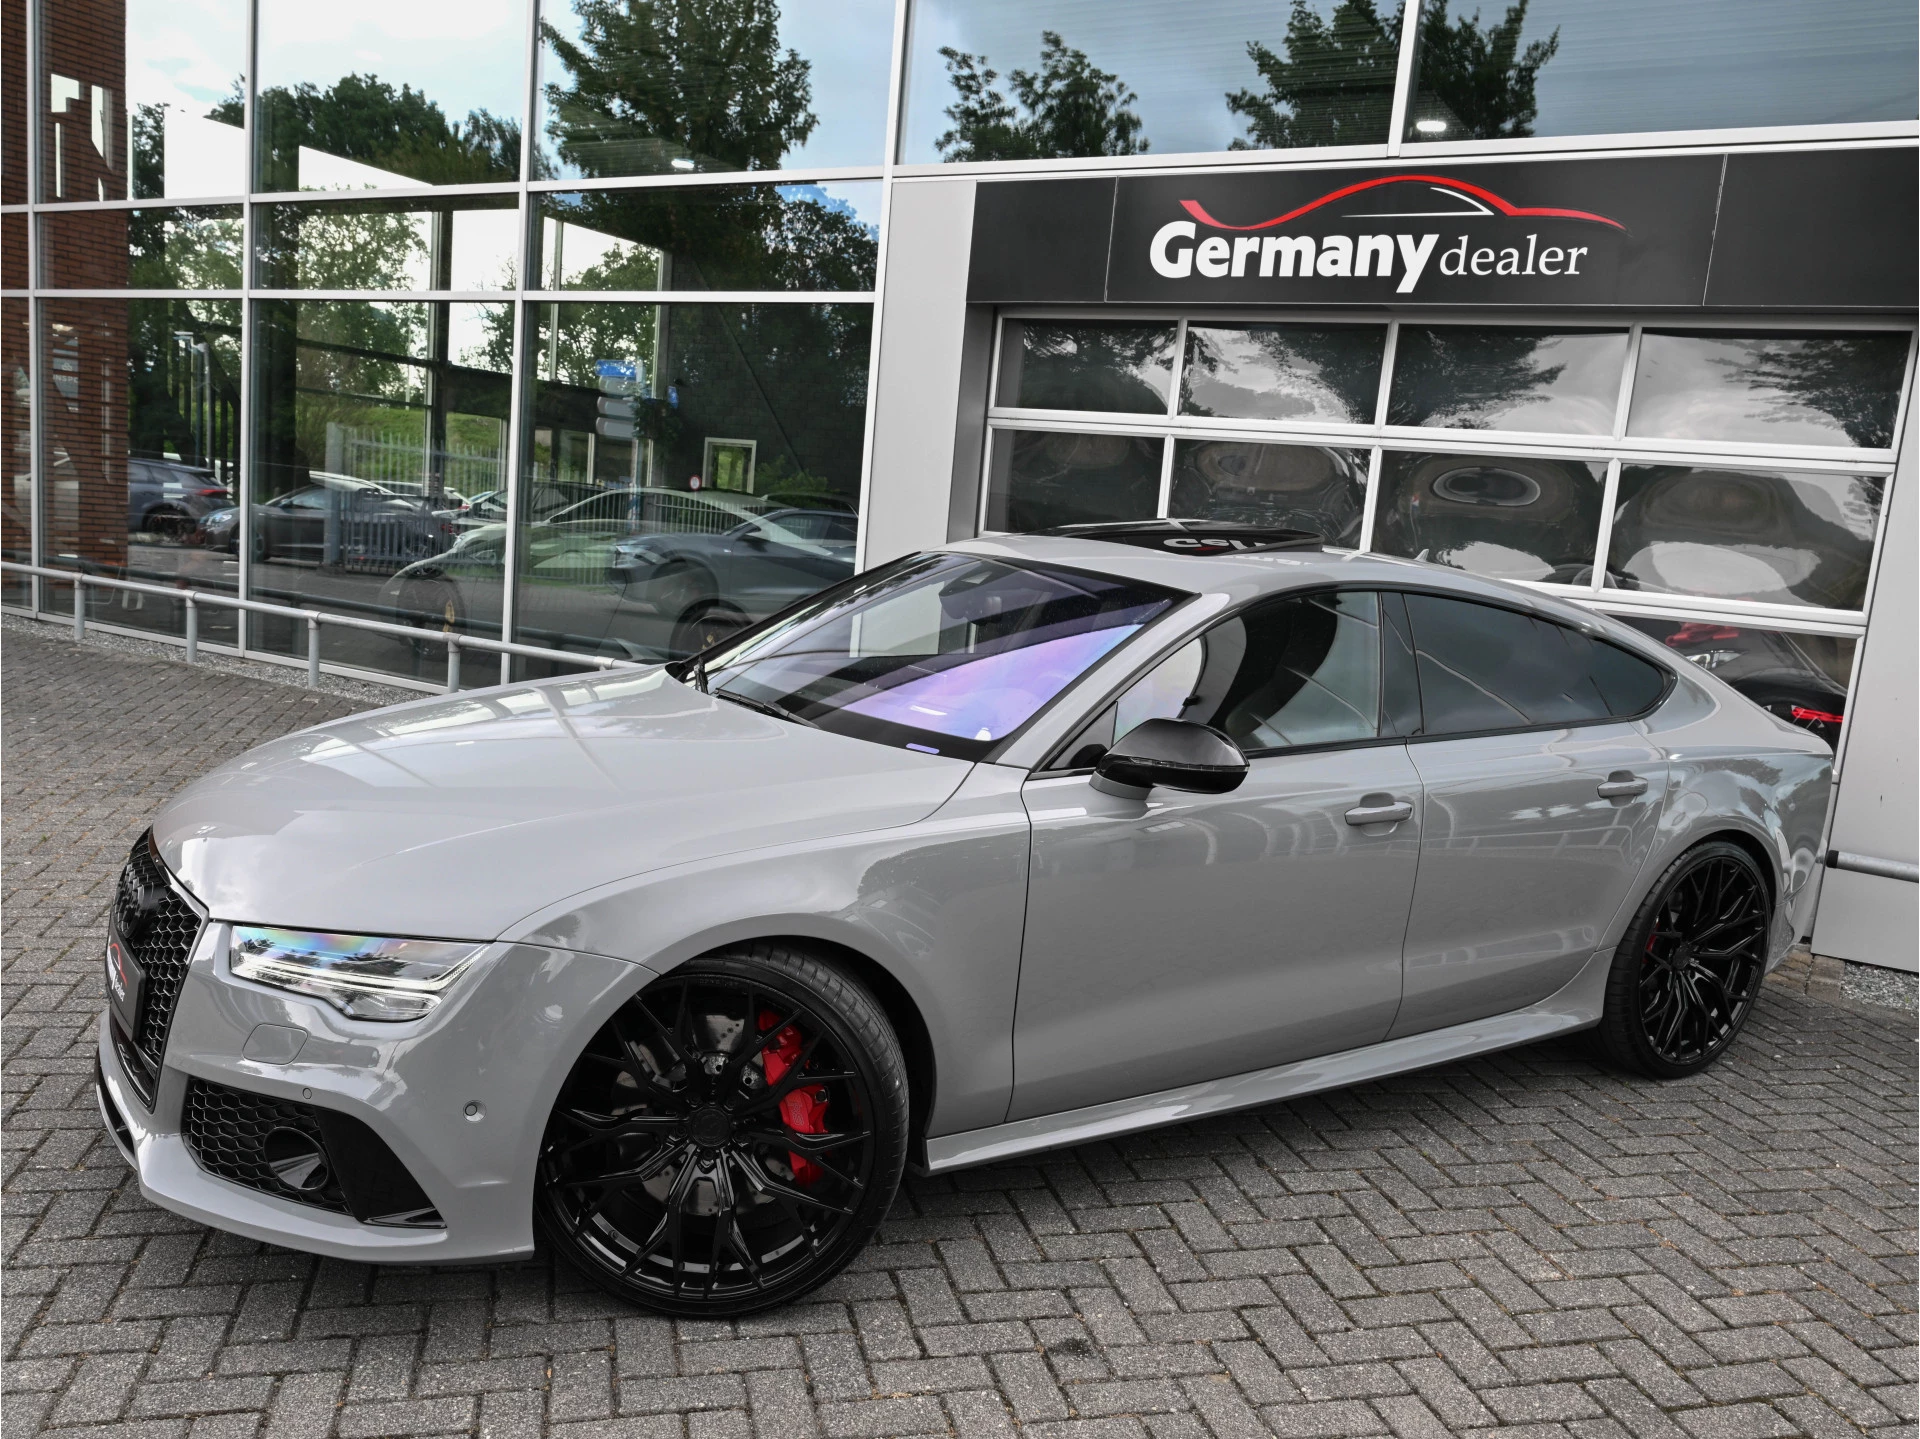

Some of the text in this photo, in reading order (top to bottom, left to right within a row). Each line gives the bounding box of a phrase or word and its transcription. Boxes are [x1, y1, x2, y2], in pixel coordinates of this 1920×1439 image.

[1150, 220, 1588, 293] Germany dealer
[788, 1101, 805, 1126] RS
